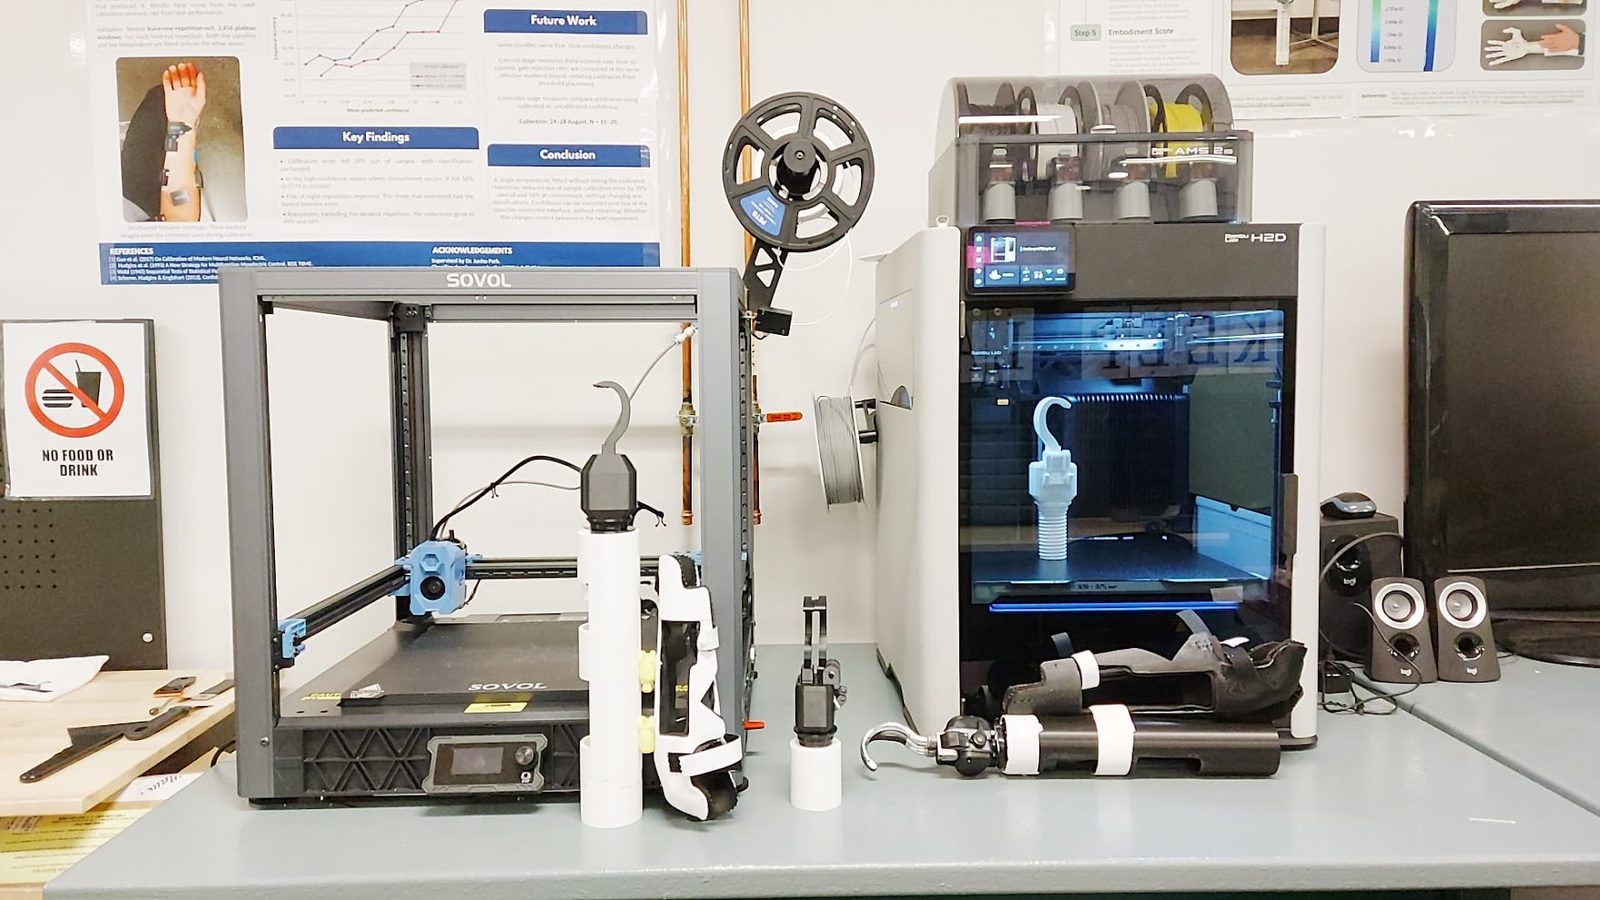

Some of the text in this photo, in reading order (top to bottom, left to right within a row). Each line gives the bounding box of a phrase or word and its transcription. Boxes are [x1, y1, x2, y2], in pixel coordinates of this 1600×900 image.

[531, 15, 597, 26] Future Work
[1074, 29, 1090, 38] Step
[1108, 27, 1174, 36] Embodiment Score
[343, 131, 410, 144] Key Findings
[540, 149, 596, 160] Conclusion
[1176, 147, 1208, 155] AMS
[1250, 233, 1287, 242] H2D
[432, 246, 512, 254] ACKNOWLEDGEMENTS
[446, 273, 511, 288] SOVOL
[42, 449, 113, 462] NO FOOD OR
[60, 464, 98, 476] DRINK
[1344, 576, 1356, 587] logi
[1401, 668, 1411, 676] logi
[1467, 667, 1477, 676] logi
[468, 682, 548, 690] SOVOL
